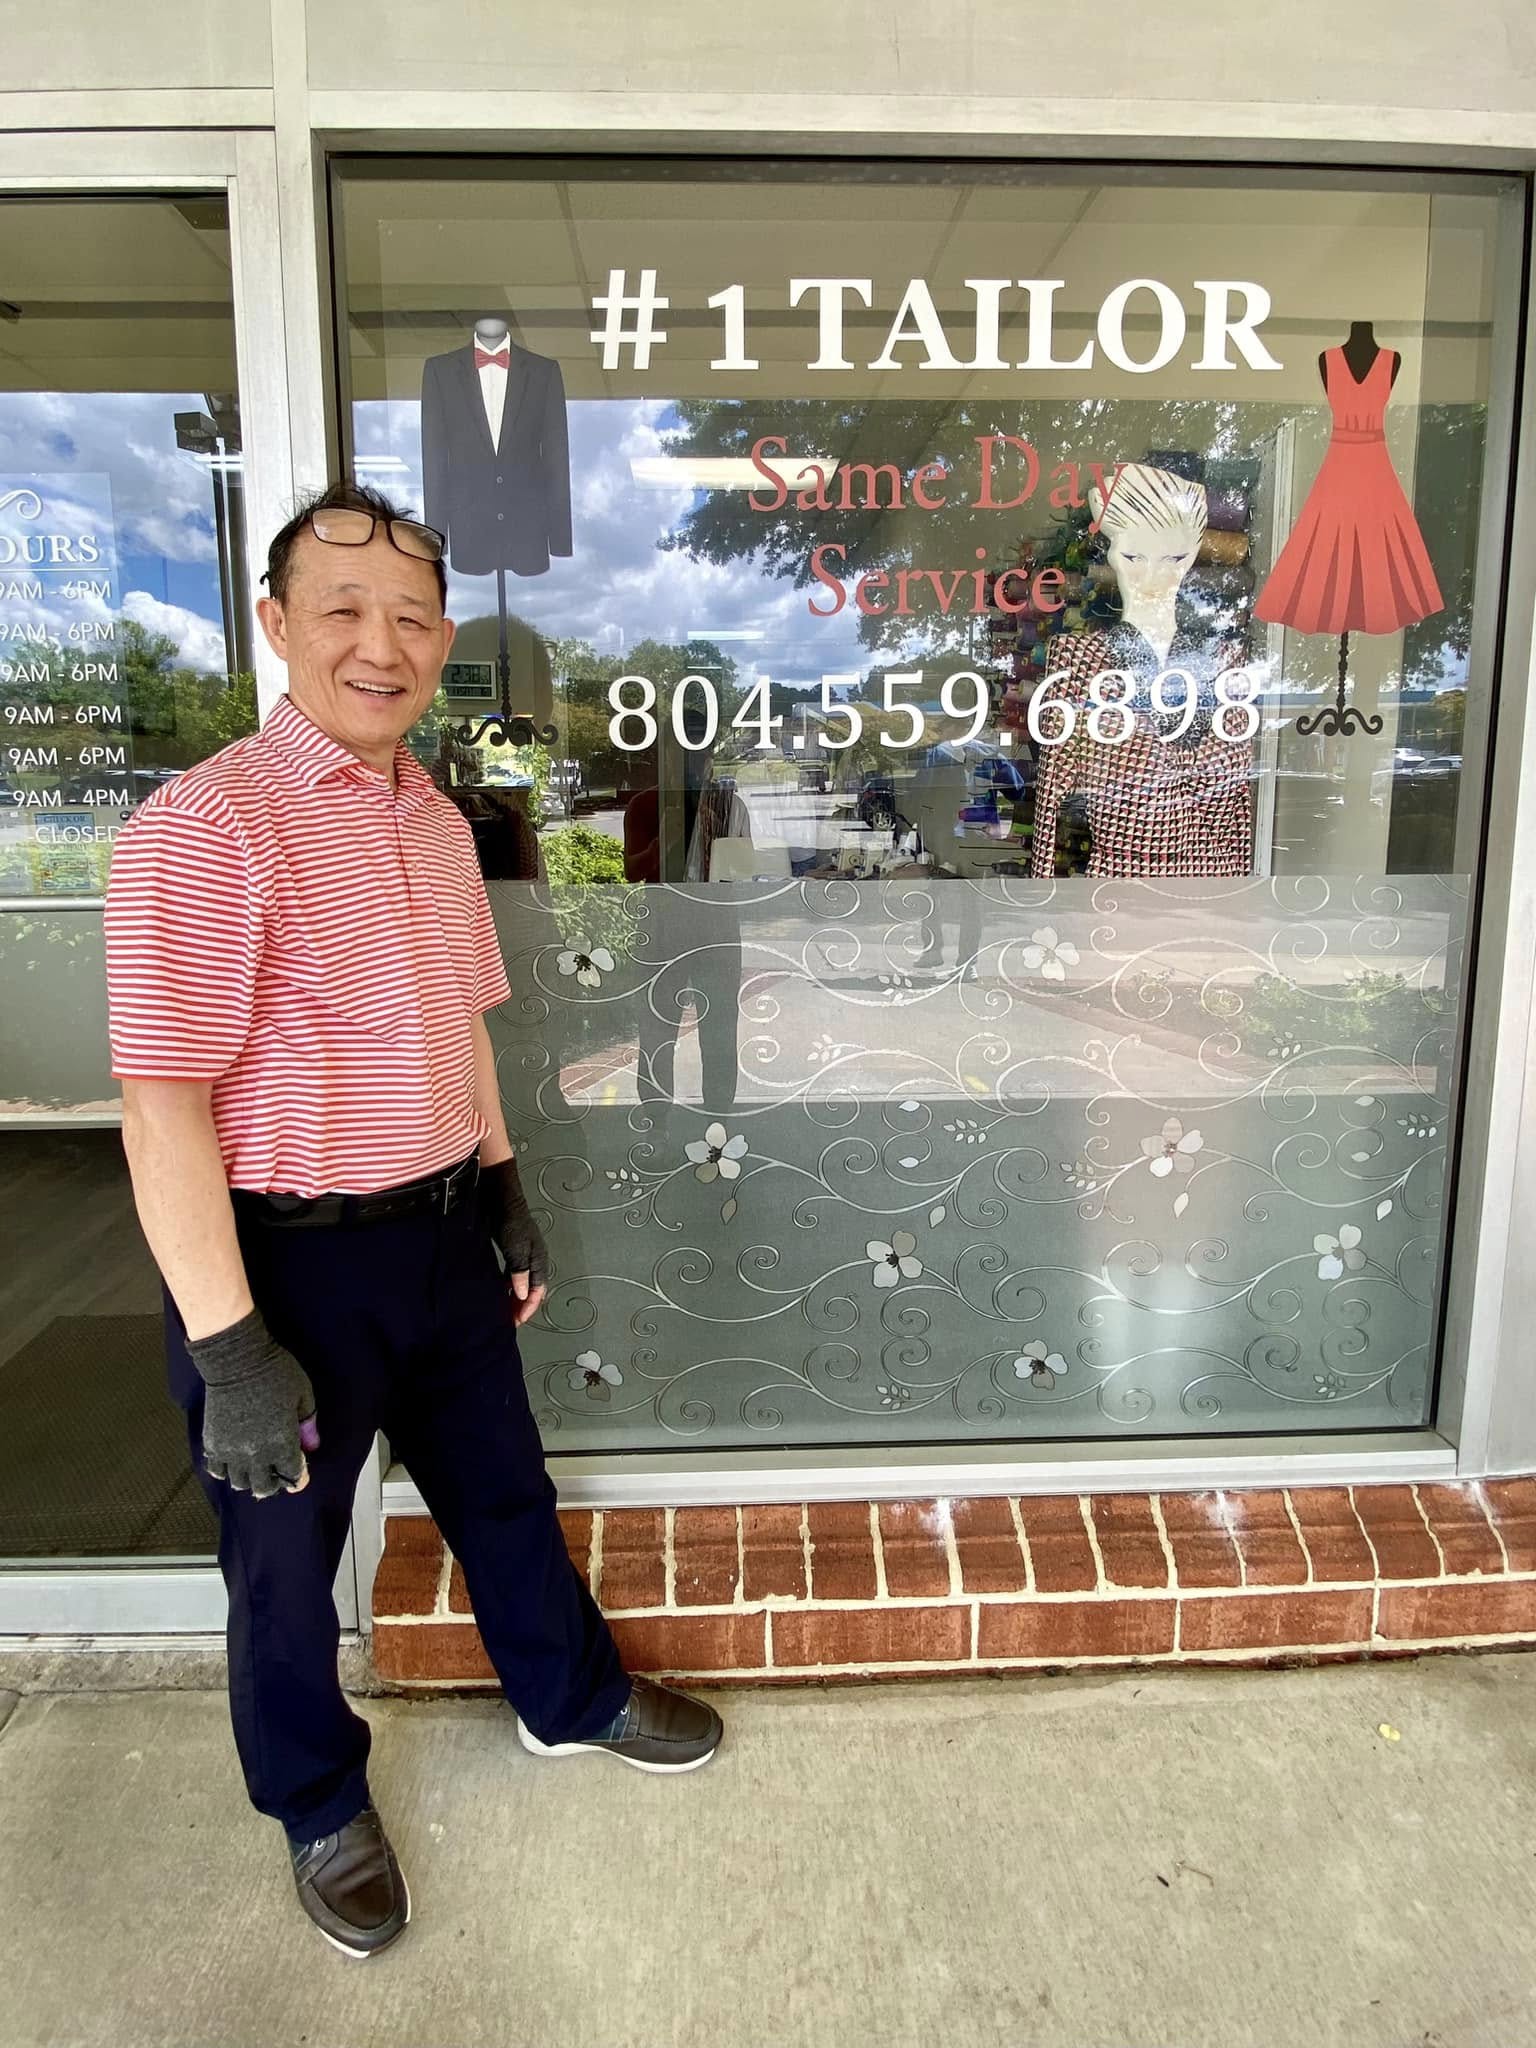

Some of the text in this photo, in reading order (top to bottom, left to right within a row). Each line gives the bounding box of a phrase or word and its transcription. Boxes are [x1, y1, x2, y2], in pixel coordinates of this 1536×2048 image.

[790, 277, 1284, 374] TAILOR
[748, 436, 1128, 534] Same Day
[808, 543, 1065, 617] Service
[63, 581, 111, 599] 6PM
[68, 623, 115, 640] 6PM
[1, 664, 50, 682] 9AM
[72, 664, 118, 681] 6PM
[4, 706, 54, 724] 9AM
[75, 705, 122, 724] 6PM
[607, 669, 1260, 751] 804.559.6898
[9, 748, 58, 766] 9AM
[79, 747, 125, 765] 6PM
[13, 790, 62, 808] 9AM
[82, 789, 129, 807] 4PM
